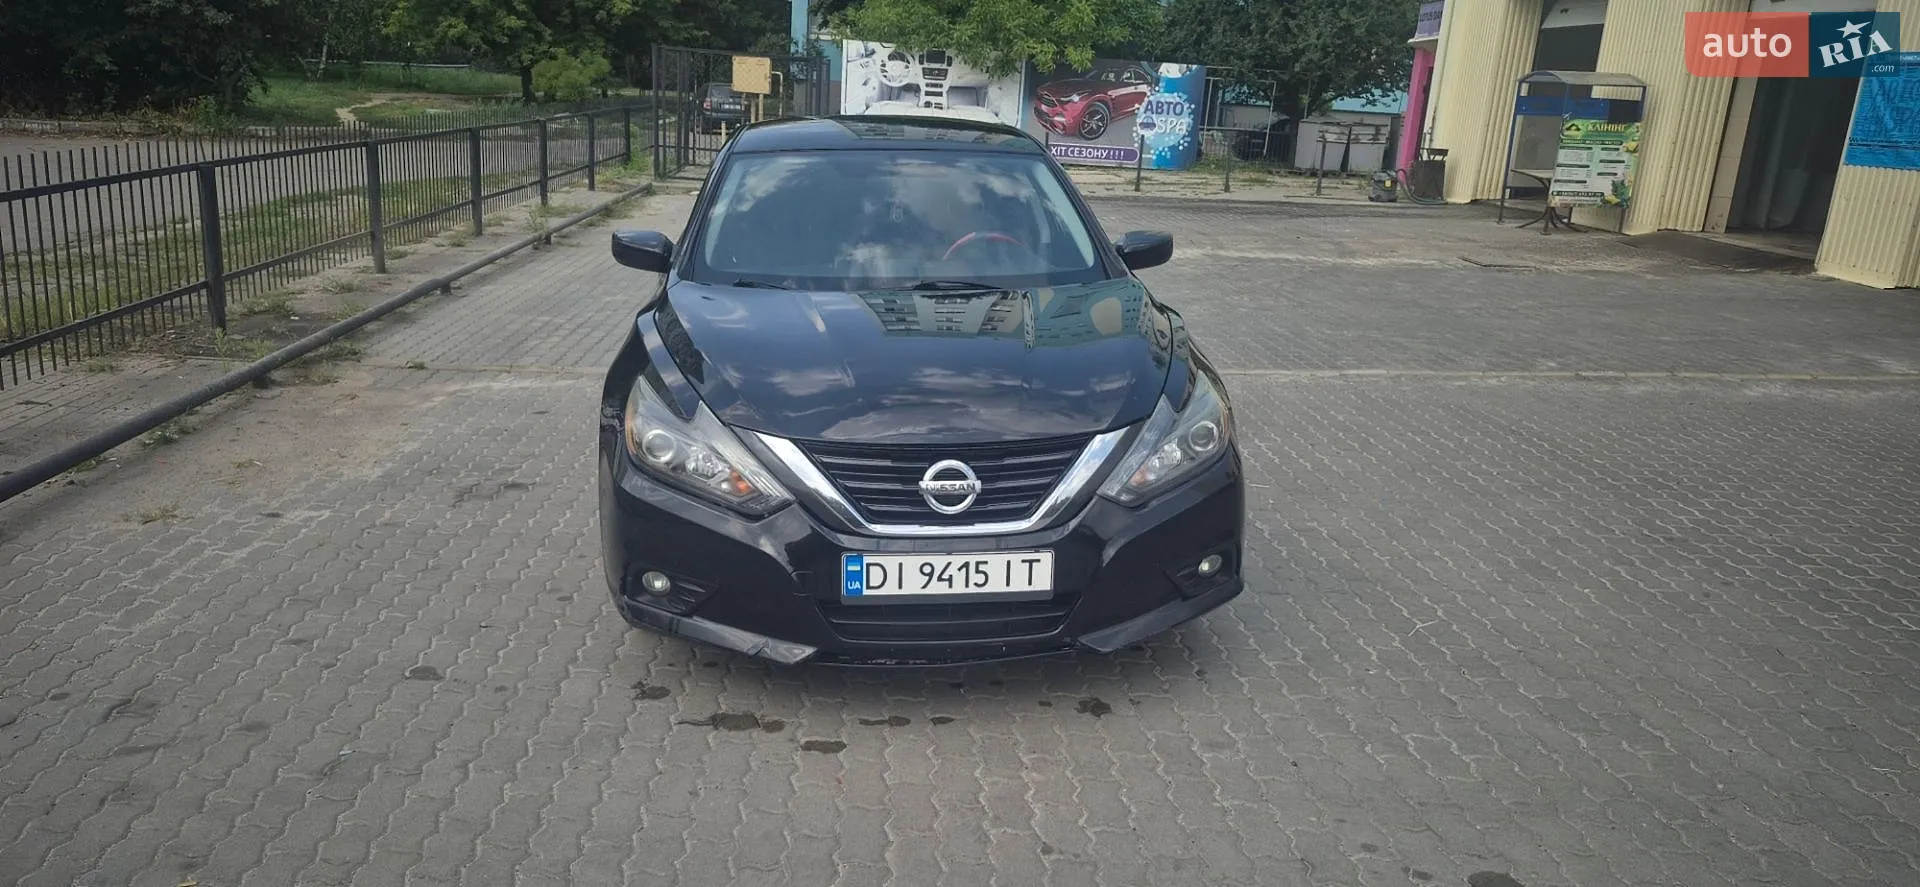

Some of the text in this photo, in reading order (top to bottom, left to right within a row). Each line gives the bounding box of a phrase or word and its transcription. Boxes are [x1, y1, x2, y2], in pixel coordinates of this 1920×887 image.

[1143, 100, 1185, 117] АВТО
[1051, 146, 1068, 156] ХІТ
[1067, 147, 1109, 159] СЕЗОНУ
[926, 483, 976, 492] NISSAN
[865, 558, 1041, 590] DI 9415 IT
[847, 581, 861, 590] UA
